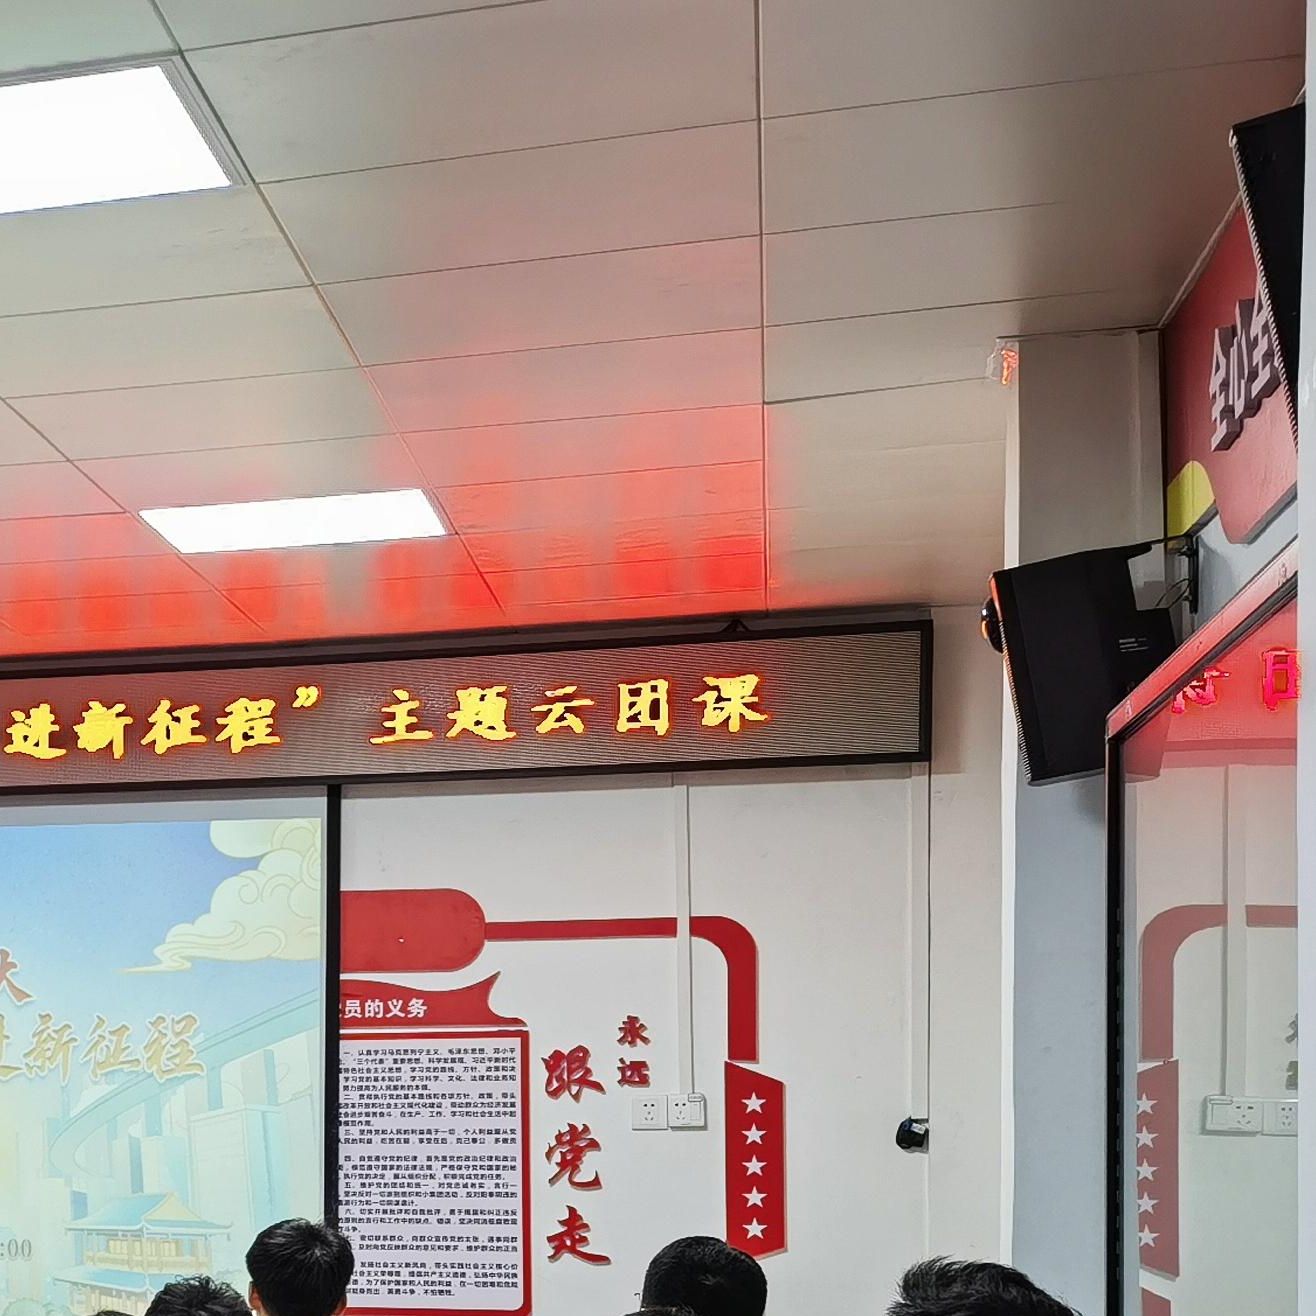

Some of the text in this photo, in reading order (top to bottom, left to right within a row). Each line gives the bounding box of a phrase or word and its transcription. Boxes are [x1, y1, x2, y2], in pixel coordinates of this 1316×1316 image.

[371, 673, 769, 746] 主题云团课
[617, 1015, 650, 1088] 永远
[541, 1045, 612, 1265] 跟党走
